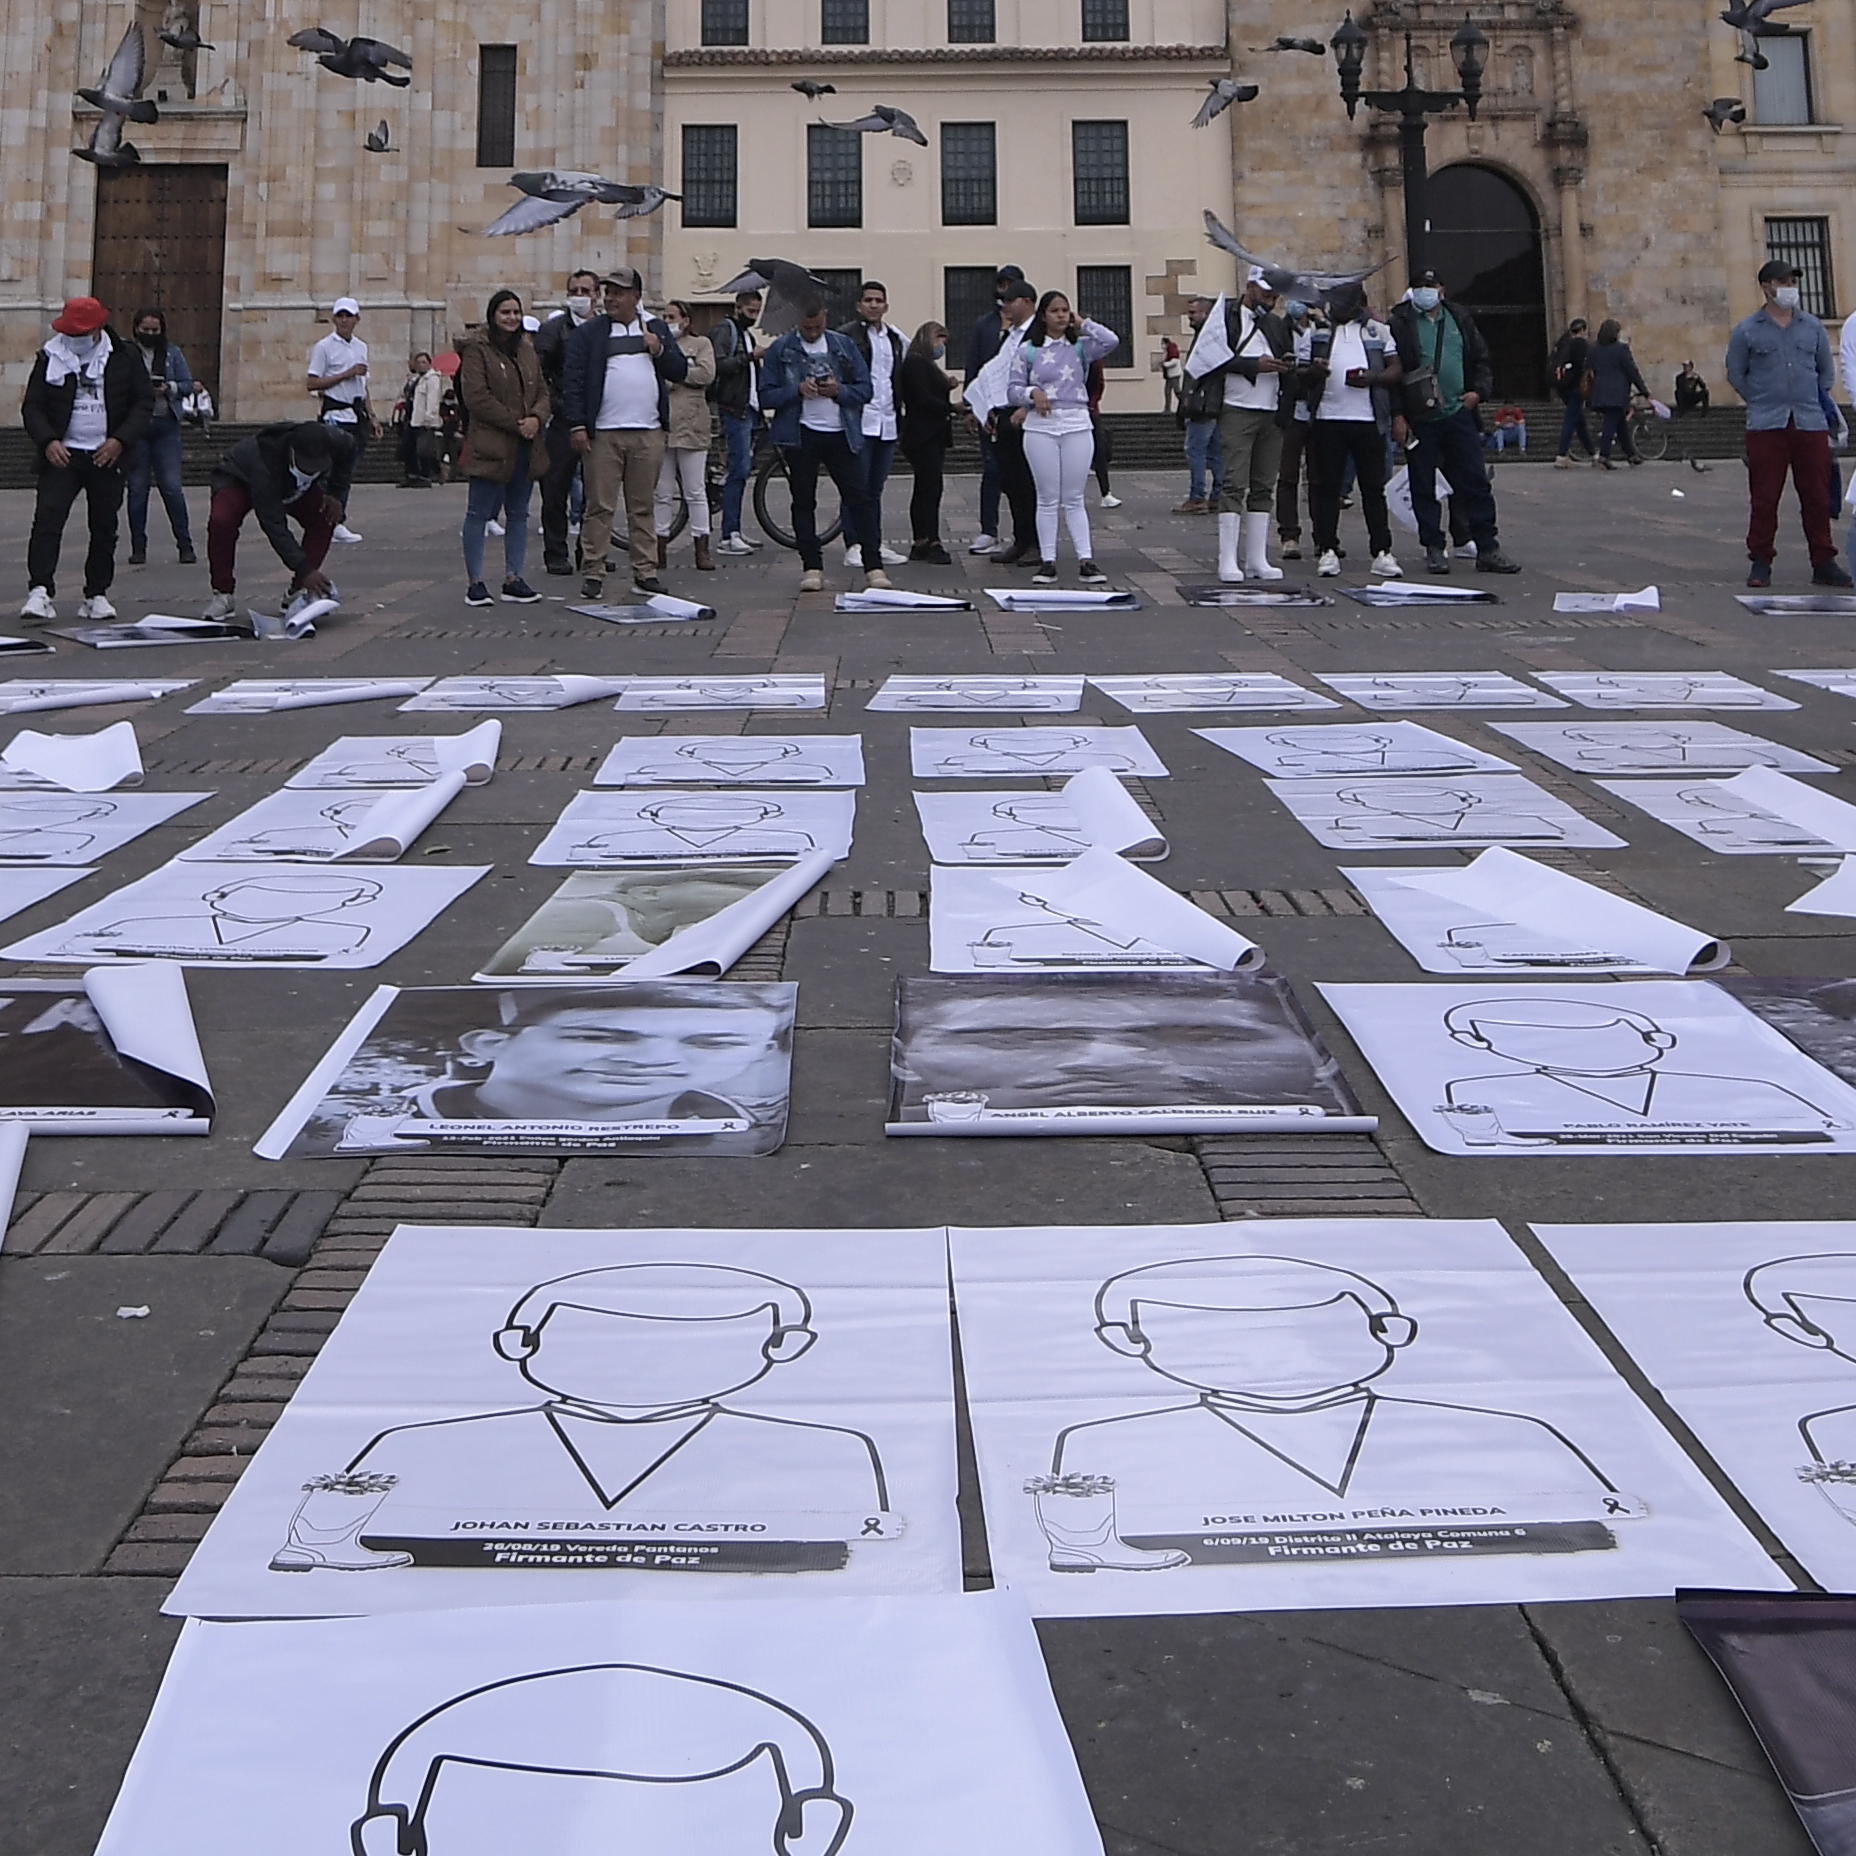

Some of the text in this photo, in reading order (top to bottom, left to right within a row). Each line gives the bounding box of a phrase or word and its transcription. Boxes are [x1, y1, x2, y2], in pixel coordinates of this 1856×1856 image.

[41, 1109, 97, 1117] ARIAS
[1054, 1110, 1133, 1118] ALBERTO
[429, 1123, 681, 1132] LEONEL ANTONIO RESTREPO
[1625, 1120, 1704, 1129] RAMÍREZ
[1200, 1506, 1507, 1527] JOSE MILTON PEÑA PINEDA
[448, 1520, 770, 1534] JOHAN SEBASTIAN CASTRO
[1273, 1533, 1342, 1544] Distrito
[1361, 1530, 1434, 1542] Atalaya
[1436, 1528, 1511, 1539] Comuna
[565, 1543, 631, 1554] Vereda
[633, 1544, 721, 1555] Pantanos
[1266, 1539, 1474, 1557] Firmante de Paz
[493, 1551, 703, 1565] Firmante de Paz
